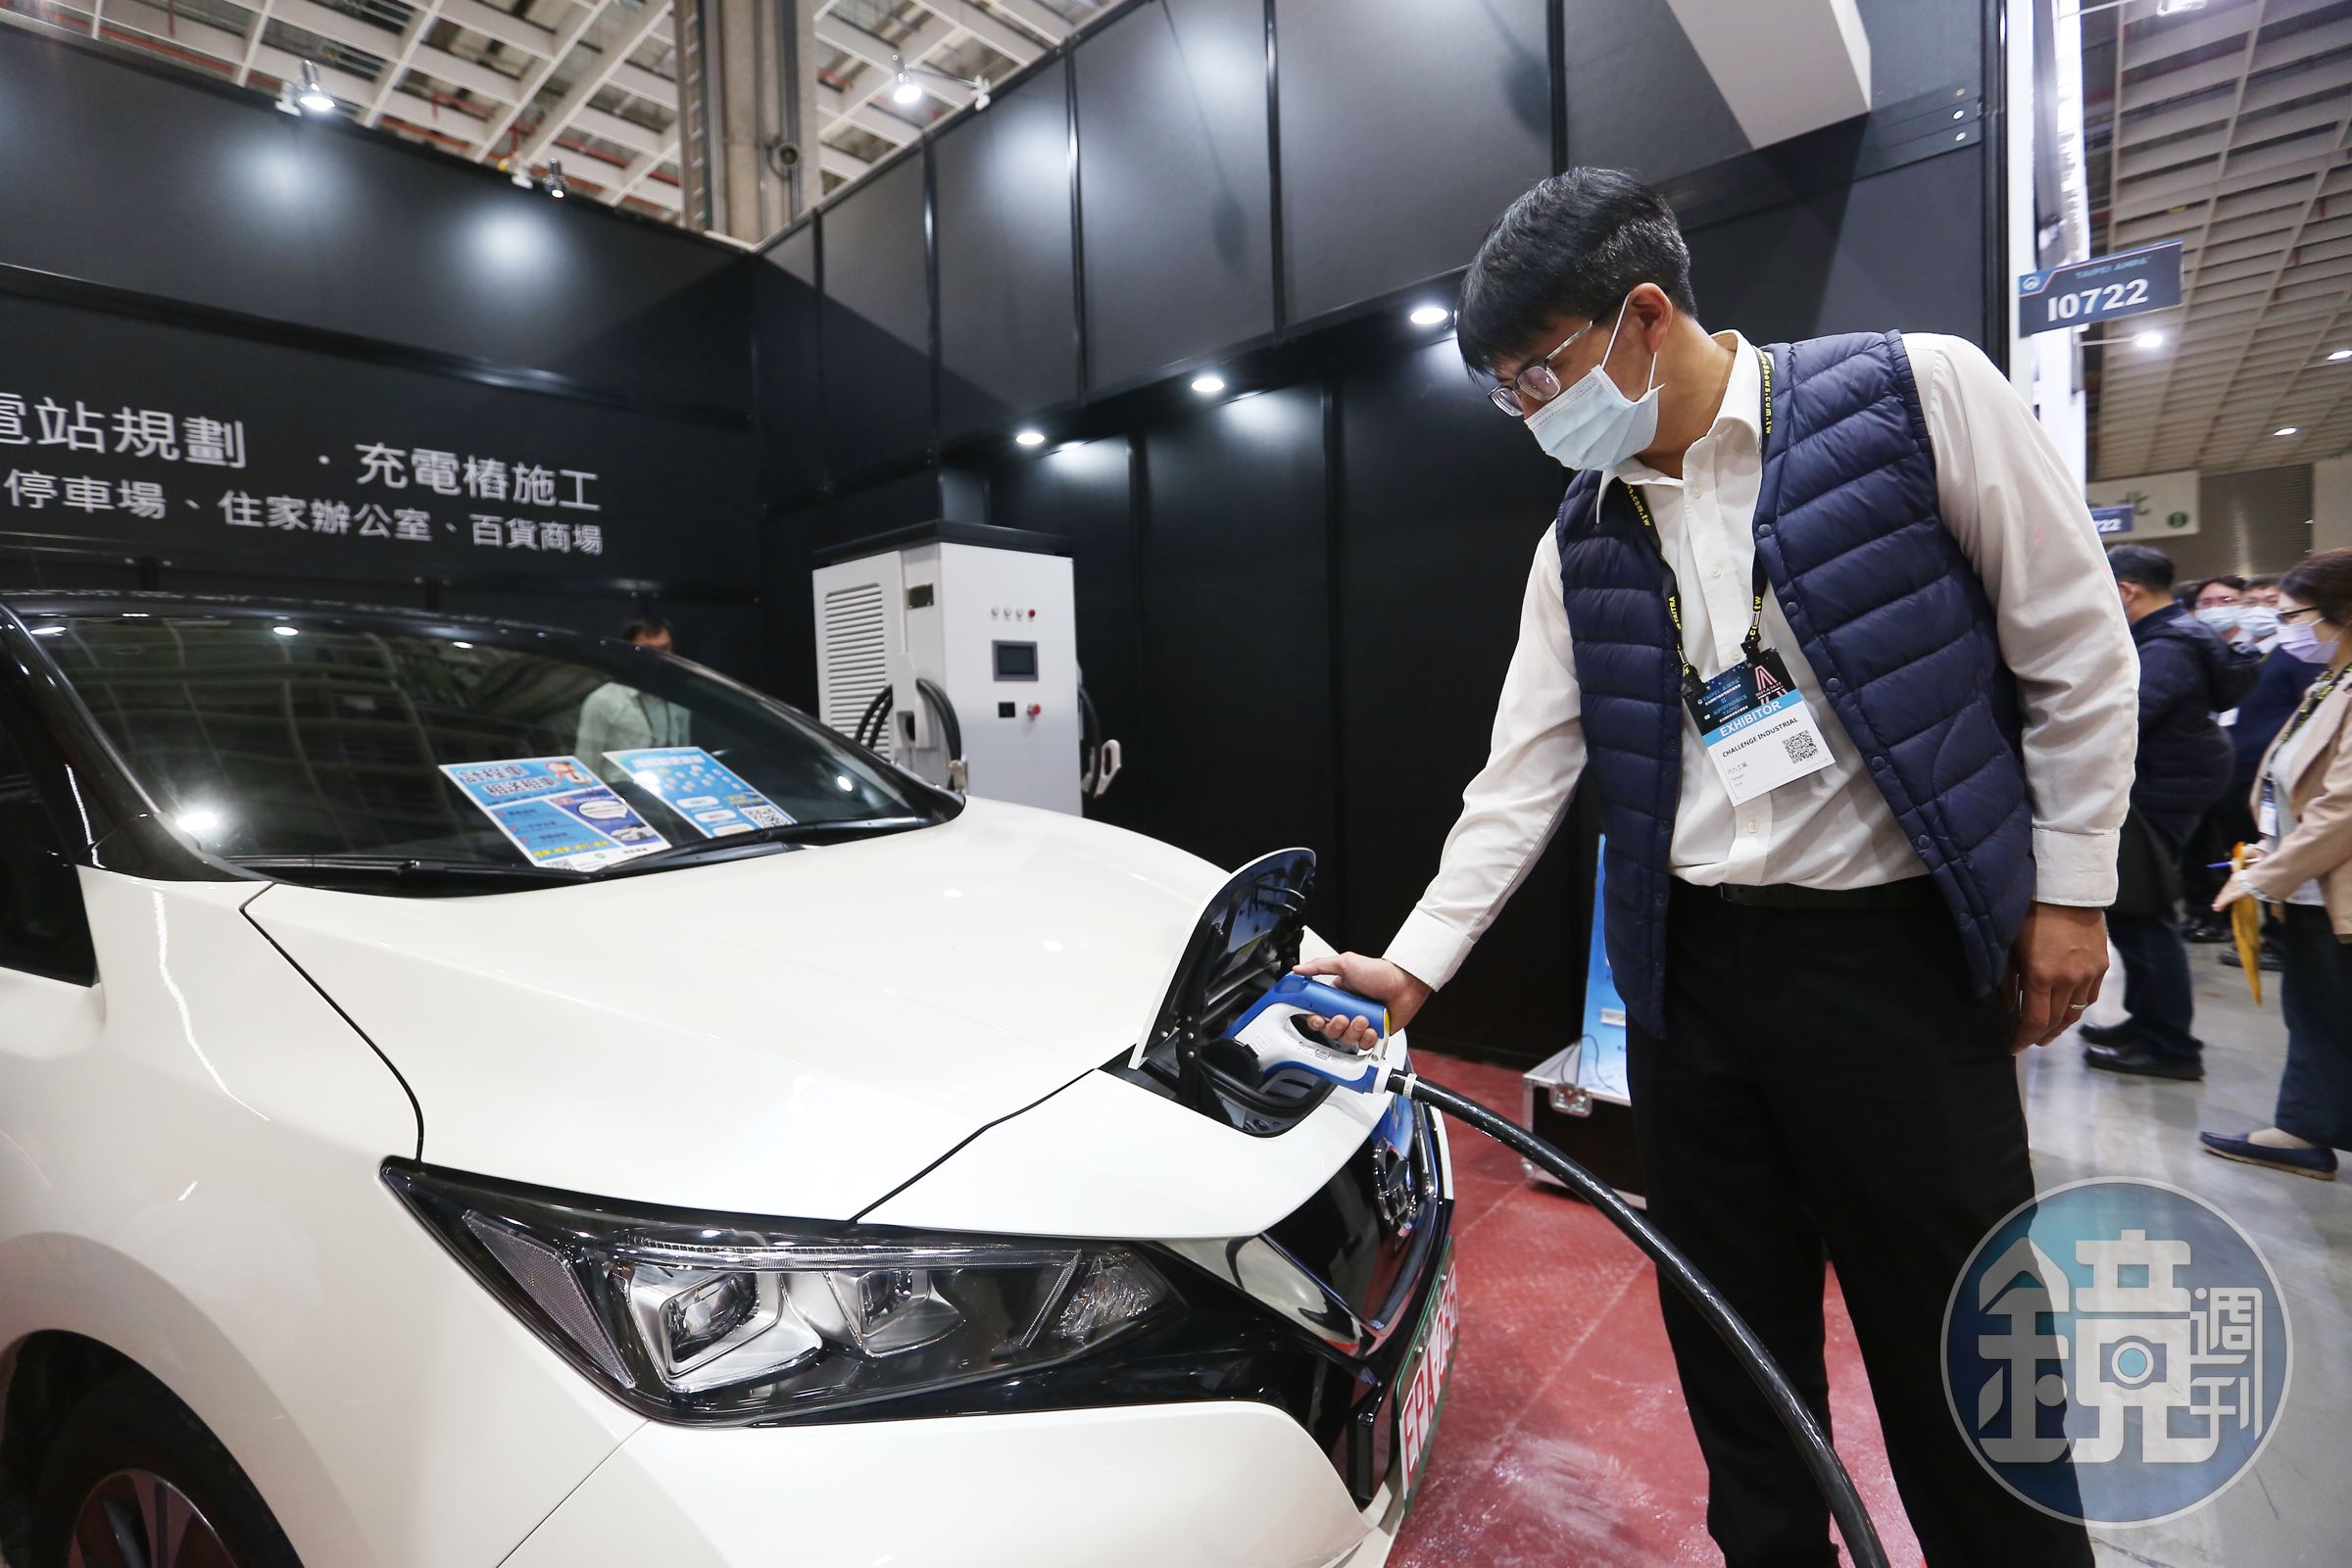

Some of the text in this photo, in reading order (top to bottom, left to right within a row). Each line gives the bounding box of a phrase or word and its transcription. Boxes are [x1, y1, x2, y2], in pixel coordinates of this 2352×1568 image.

[1720, 701, 1783, 738] EXHIBITOR
[1722, 717, 1799, 758] CHALLENGE INDUSTRIAL
